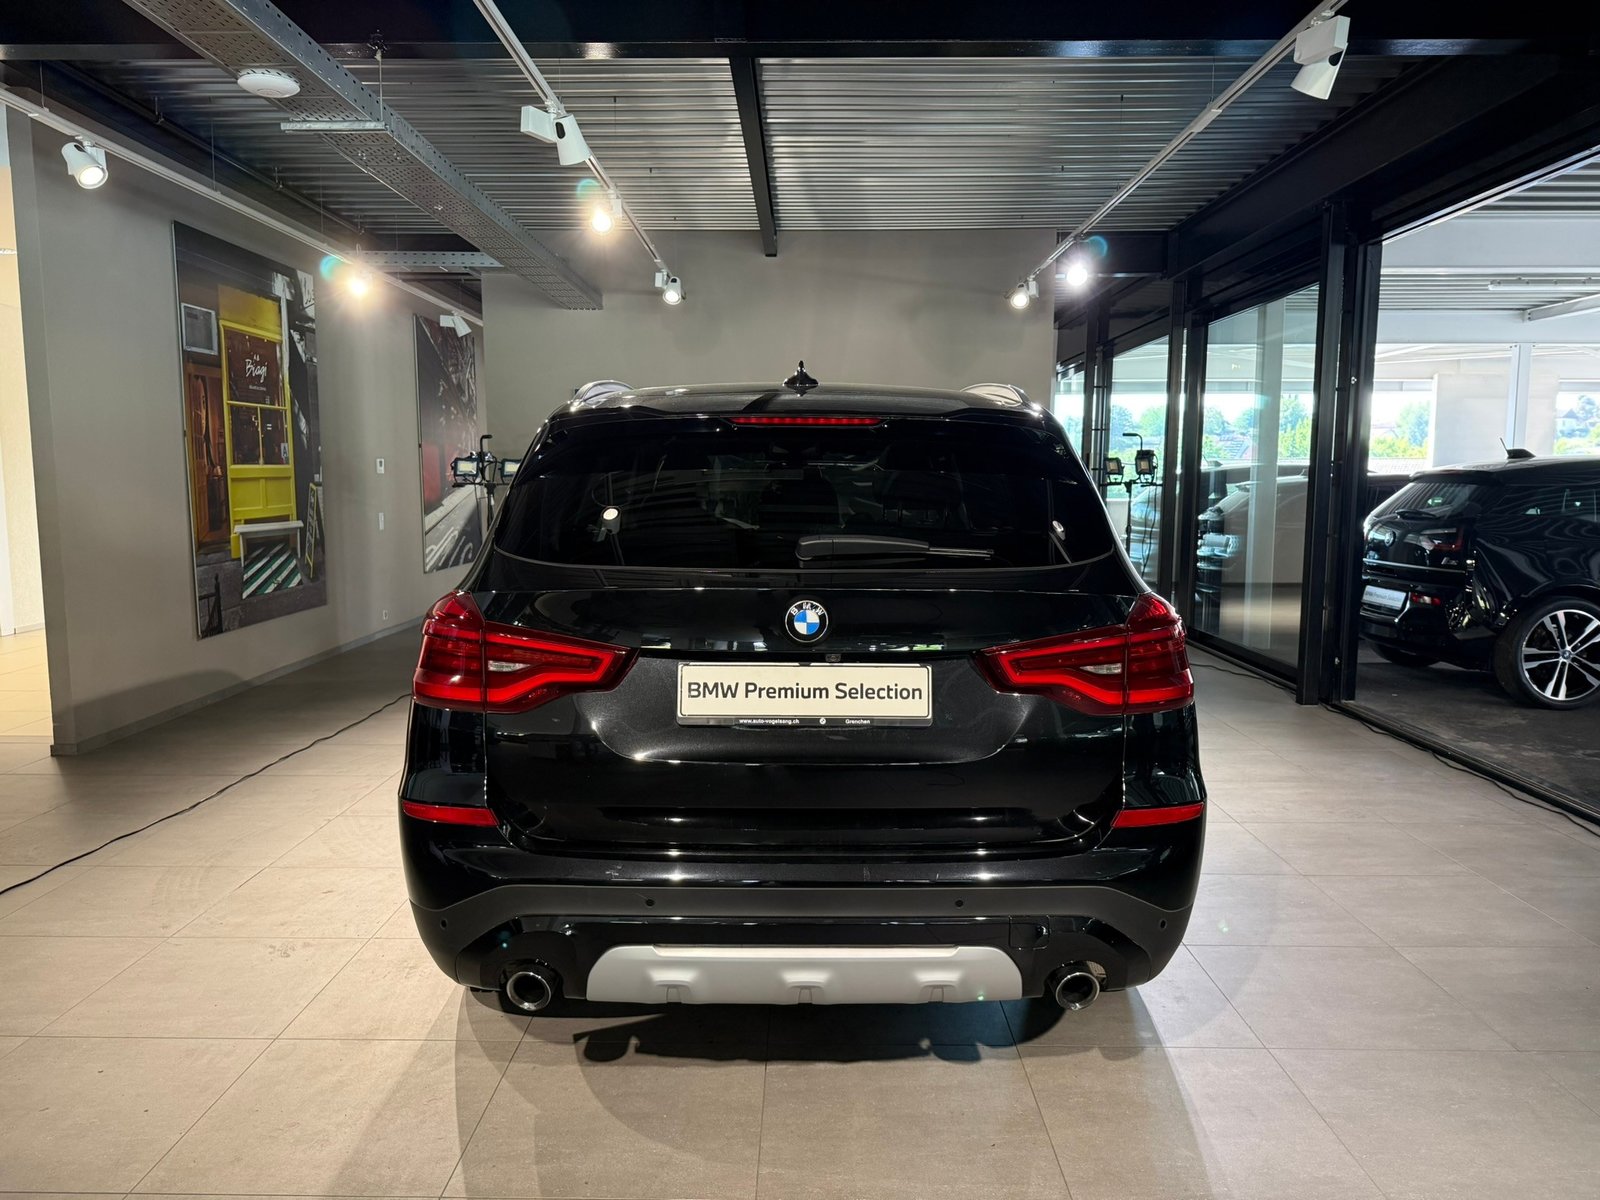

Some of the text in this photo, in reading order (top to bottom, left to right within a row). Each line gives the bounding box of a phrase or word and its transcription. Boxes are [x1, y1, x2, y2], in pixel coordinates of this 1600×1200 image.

[790, 601, 825, 616] BMW
[687, 681, 923, 701] BMW Premium Selection
[738, 718, 871, 726] www.auto-vogelsang.ch Grenchen
